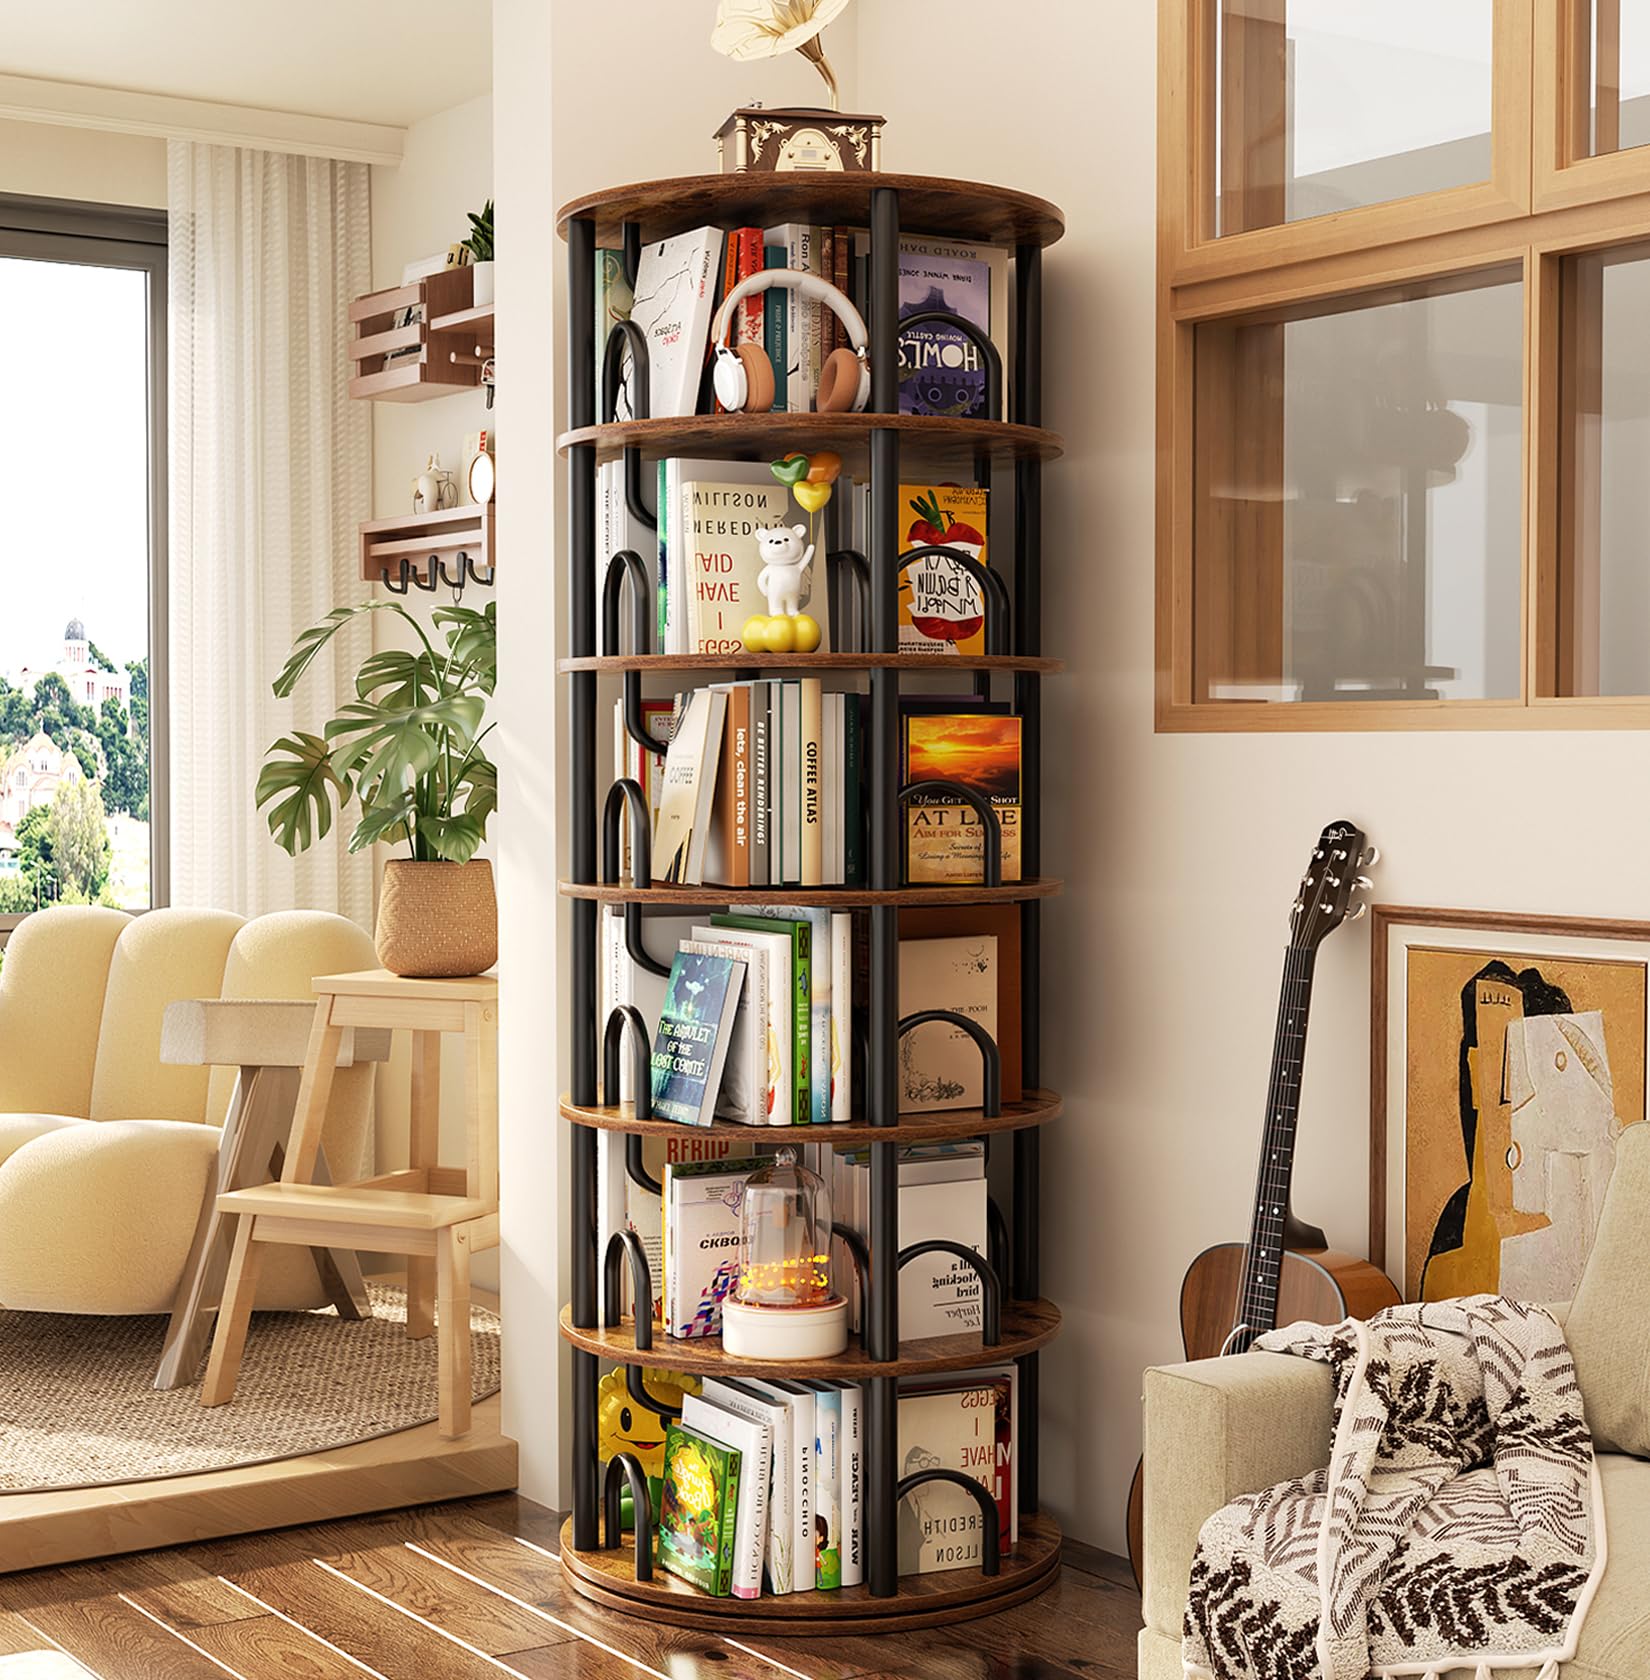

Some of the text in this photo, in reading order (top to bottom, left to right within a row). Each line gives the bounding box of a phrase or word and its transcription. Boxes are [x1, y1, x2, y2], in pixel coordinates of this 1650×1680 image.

[801, 233, 811, 259] Ron
[900, 242, 977, 259] ROALD DAH
[898, 268, 972, 283] DIANA WYNNE JONES
[811, 314, 820, 347] DAYS
[906, 331, 963, 342] MOVING CASTLE
[898, 337, 979, 373] HOWL'S
[736, 728, 746, 847] lets, clean the air
[757, 721, 765, 845] BE BETTER RENDERINGS
[806, 741, 817, 824] COFFEE ATLAS
[913, 793, 940, 808] You
[990, 795, 1018, 805] SHOT
[913, 809, 1017, 826] AT LIE
[913, 827, 1017, 838] AIM FOR SUSS
[658, 1020, 712, 1044] THE AMULET
[667, 1040, 693, 1057] OF THE
[651, 1052, 673, 1070] LOST
